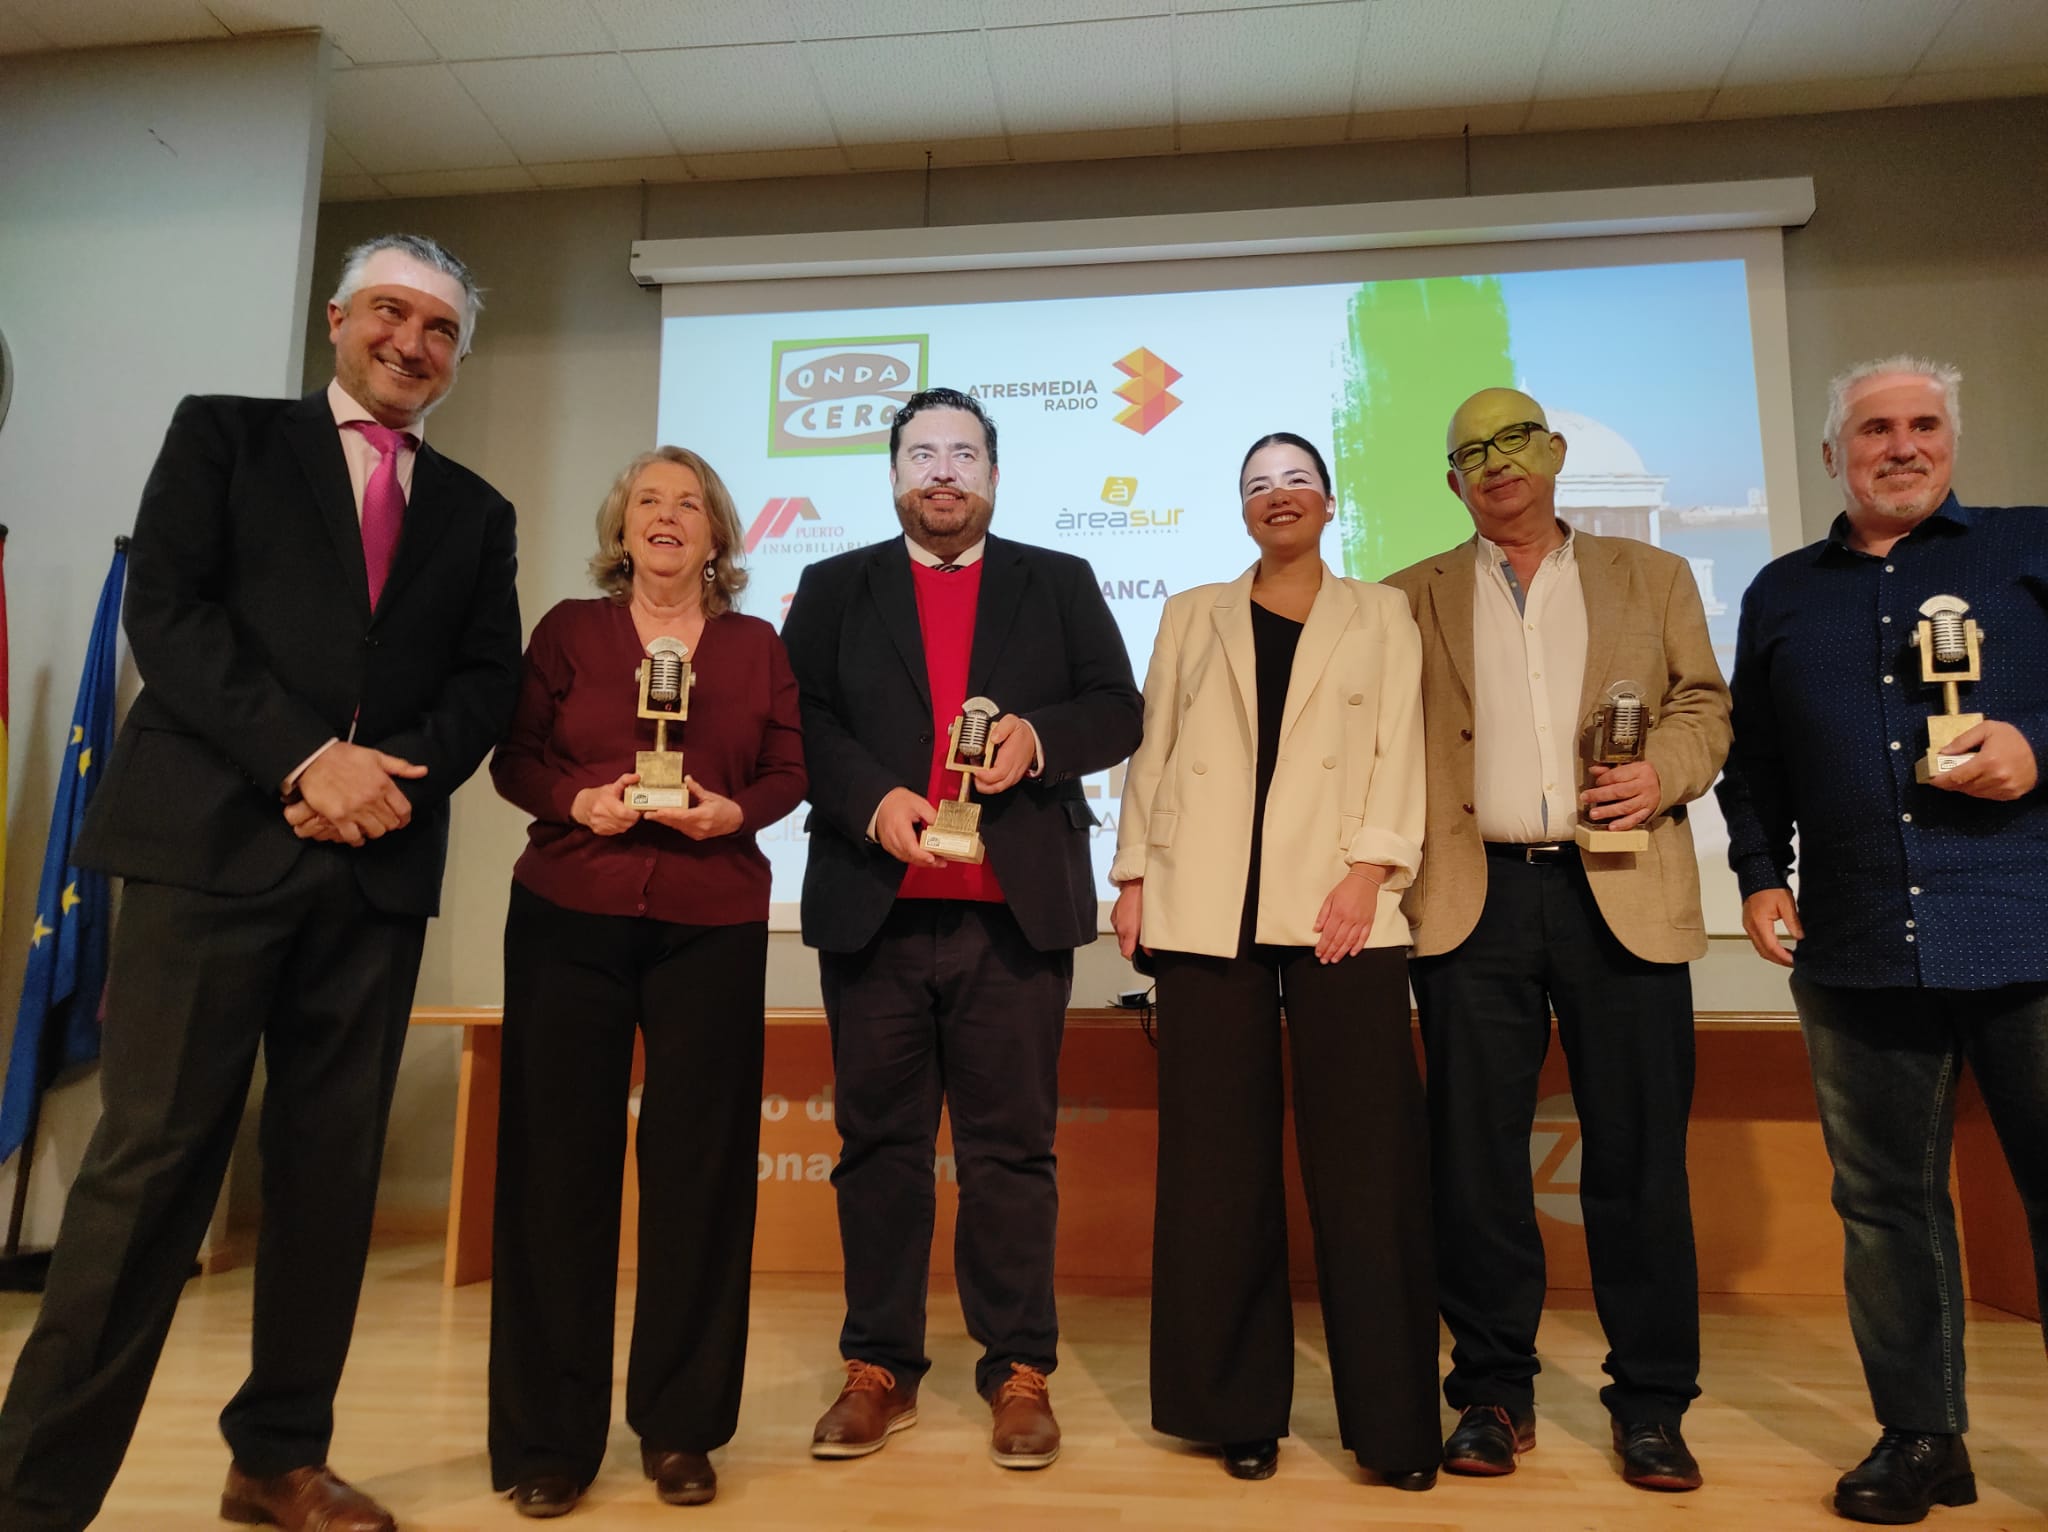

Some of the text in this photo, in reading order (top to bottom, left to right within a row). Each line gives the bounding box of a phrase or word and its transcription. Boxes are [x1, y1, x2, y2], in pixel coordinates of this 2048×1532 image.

[798, 365, 898, 389] ONDA
[968, 379, 1098, 399] ATRESMEDIA
[1044, 397, 1098, 411] RADIO
[801, 404, 897, 431] CERO
[796, 526, 845, 538] PUERTO
[1102, 579, 1169, 600] ANCA
